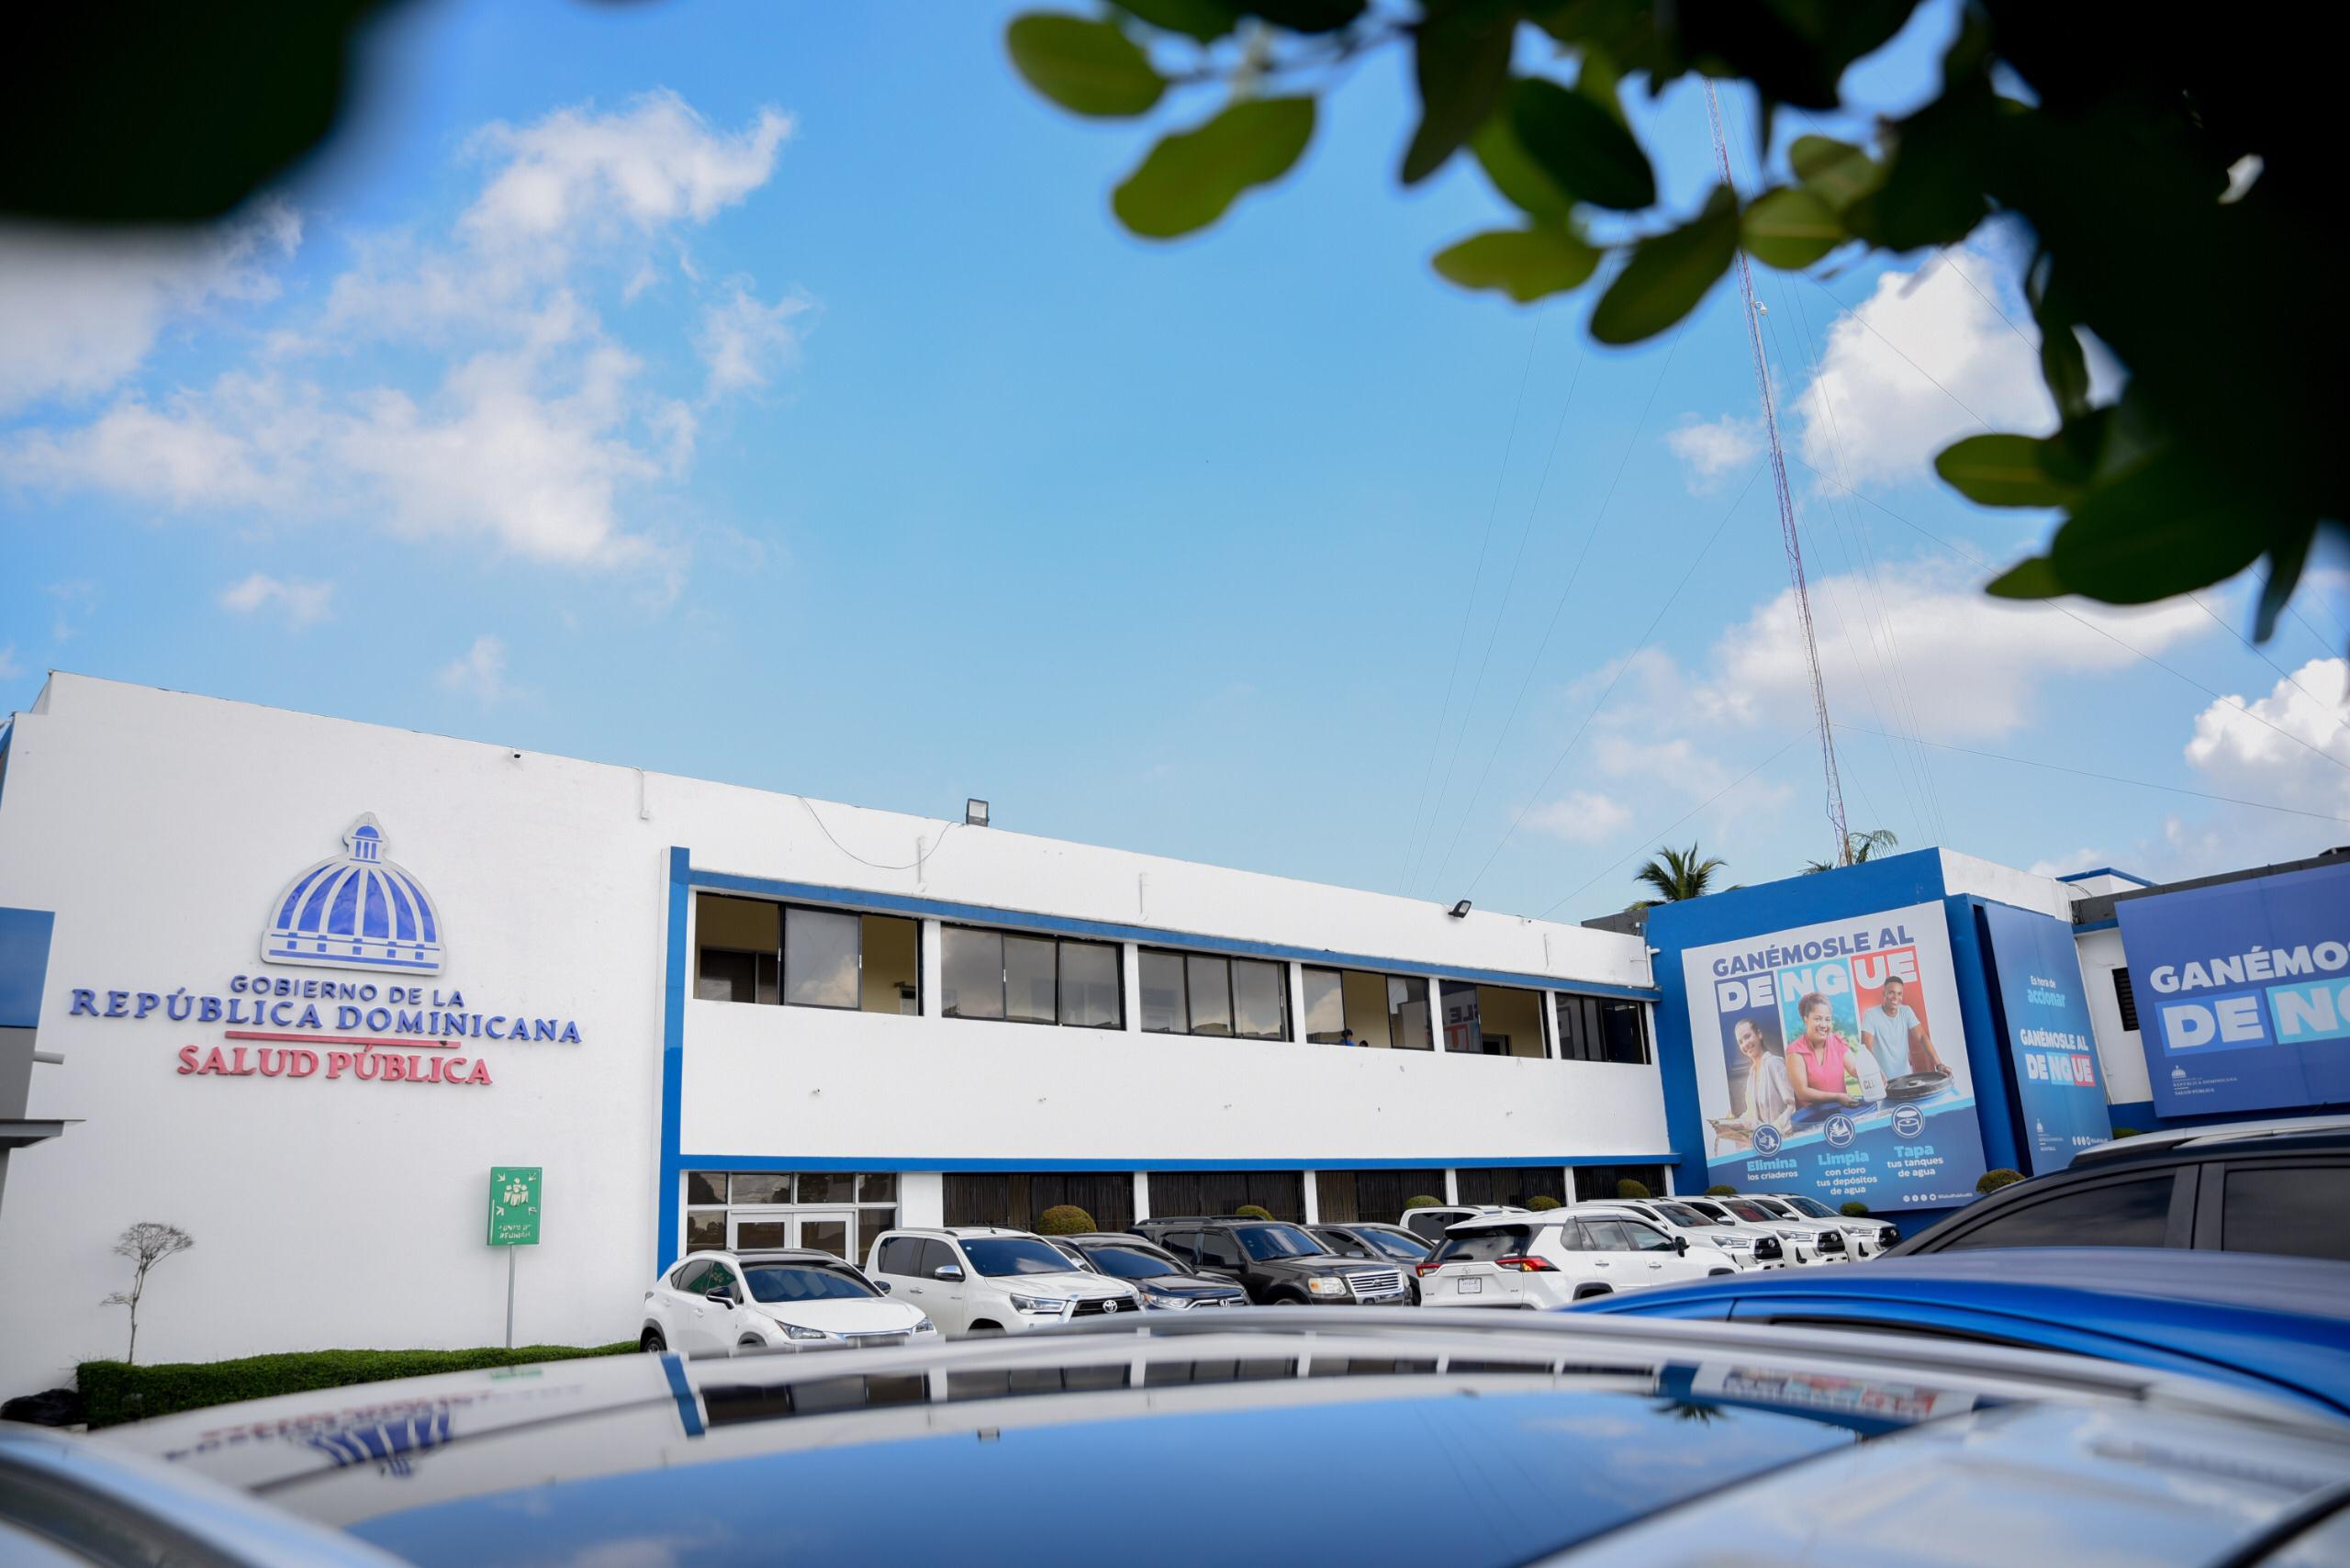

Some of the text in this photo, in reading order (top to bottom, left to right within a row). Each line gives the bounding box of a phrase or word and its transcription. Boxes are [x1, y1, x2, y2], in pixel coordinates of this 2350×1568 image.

[1712, 924, 1915, 978] GANÉMOSLE AL
[2149, 940, 2350, 994] GANÉMO
[1716, 949, 1919, 1014] DENGUE
[2037, 977, 2050, 988] hora
[2049, 979, 2056, 989] de
[229, 974, 465, 1008] GOBIERNO DE LA
[2027, 988, 2065, 1008] accionar
[68, 987, 583, 1044] REPÚBLICA DOMINICANA
[2020, 1027, 2089, 1051] GANÉMOSLE AL
[177, 1045, 494, 1086] SALUD PÚBLICA
[2025, 1053, 2094, 1082] DENGUE
[1818, 1150, 1870, 1167] Limpia
[1894, 1145, 1935, 1159] Tapa
[1746, 1157, 1798, 1172] Elimina
[1825, 1166, 1866, 1177] con cloro
[1886, 1157, 1944, 1169] tus tanques
[1747, 1170, 1798, 1182] los criaderos
[1816, 1175, 1878, 1187] tus depósitos
[1897, 1167, 1936, 1178] de agua
[1830, 1185, 1866, 1196] de agua
